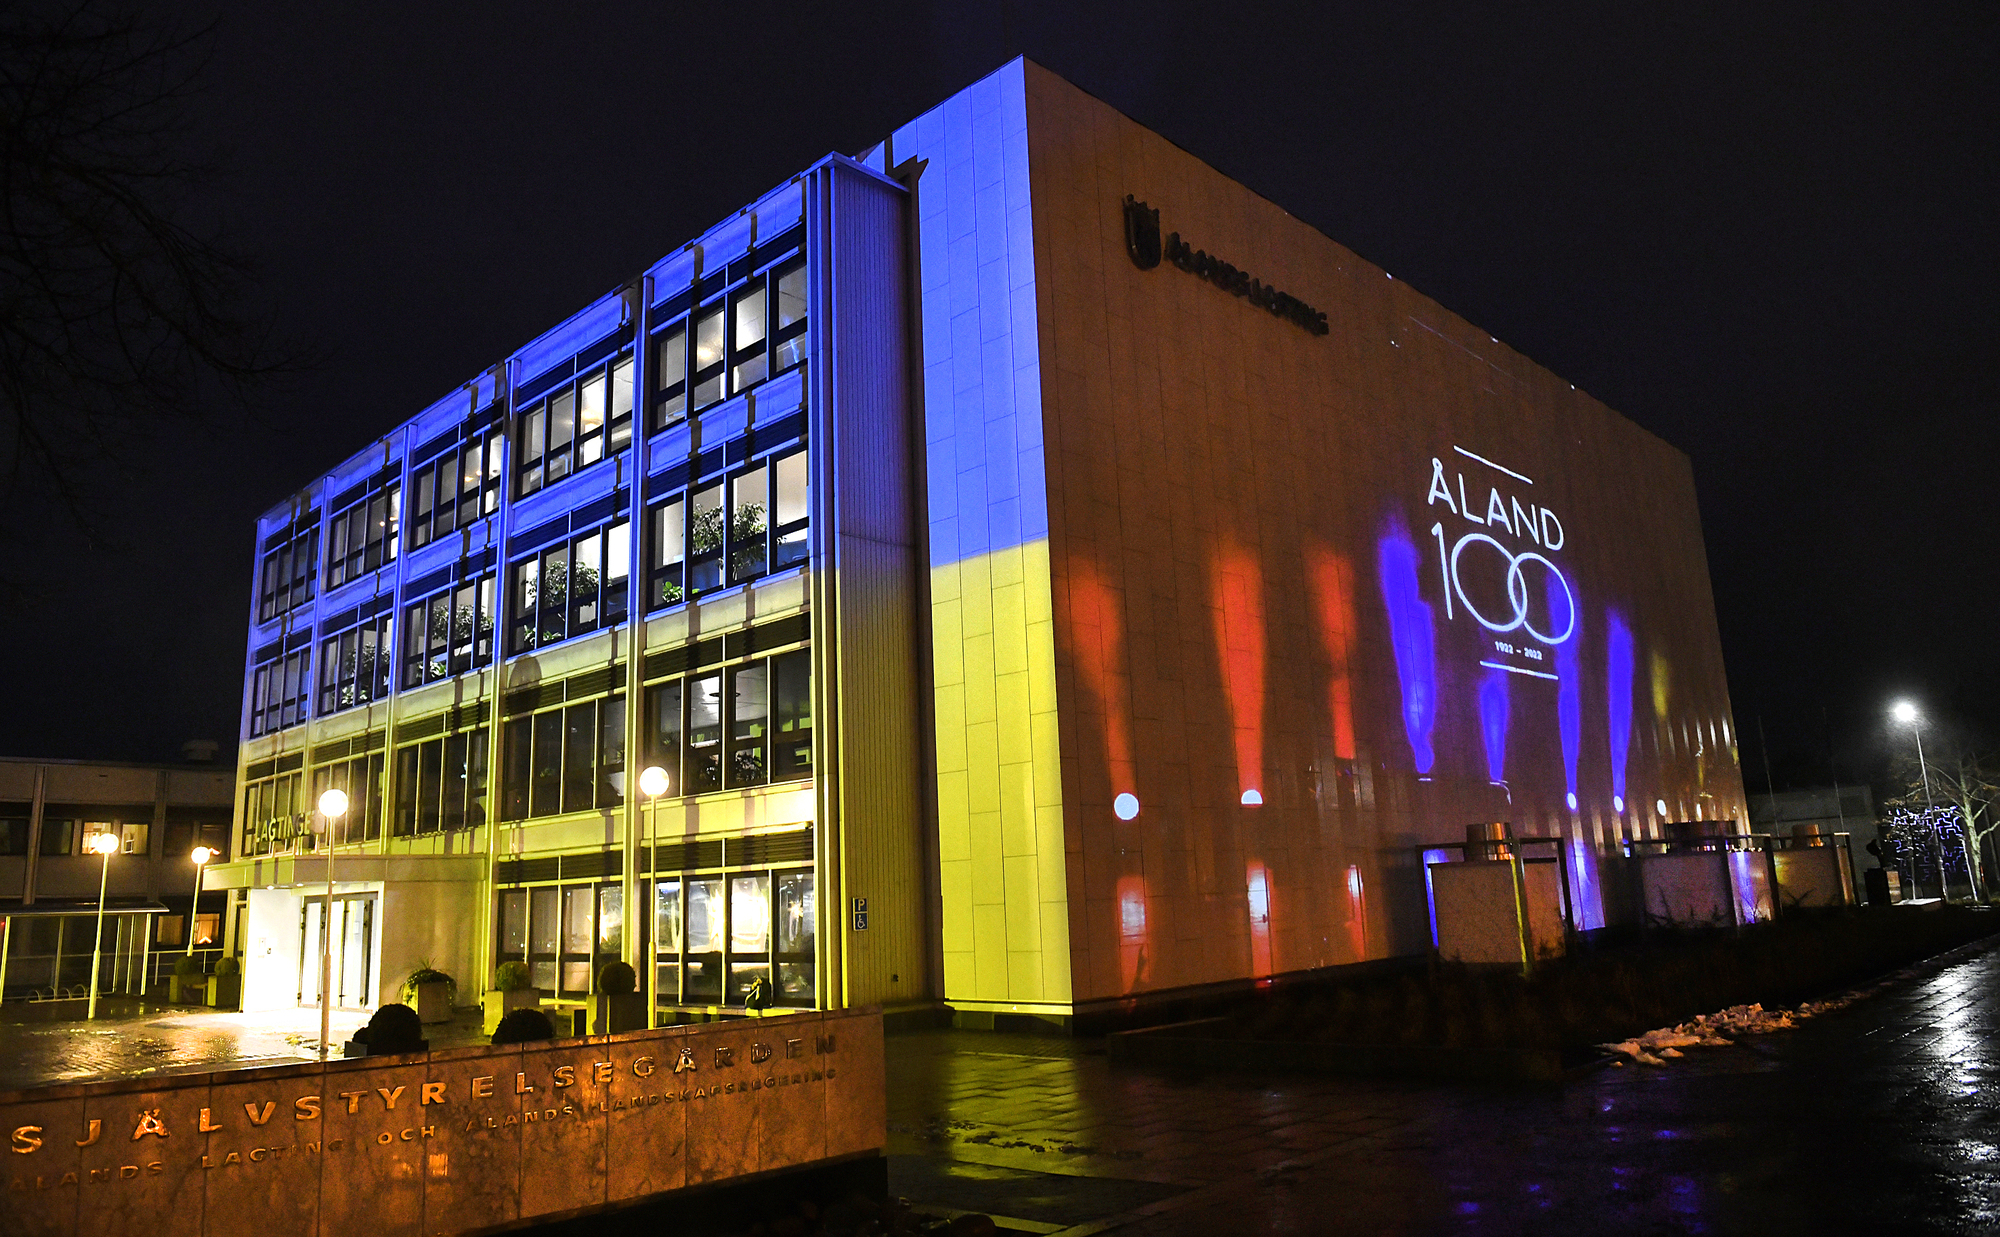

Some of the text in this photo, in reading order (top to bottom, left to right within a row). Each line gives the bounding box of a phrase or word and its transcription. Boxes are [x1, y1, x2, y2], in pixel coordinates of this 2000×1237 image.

[1427, 457, 1564, 551] ÅLAND
[1431, 522, 1575, 645] 100
[1494, 640, 1514, 655] 1922
[1523, 646, 1543, 661] 2022
[858, 898, 866, 911] P
[11, 1034, 837, 1154] SJÄLVSTYRELSEGÅRDEN
[201, 1138, 344, 1170] LAGTING
[377, 1125, 435, 1146] OCH
